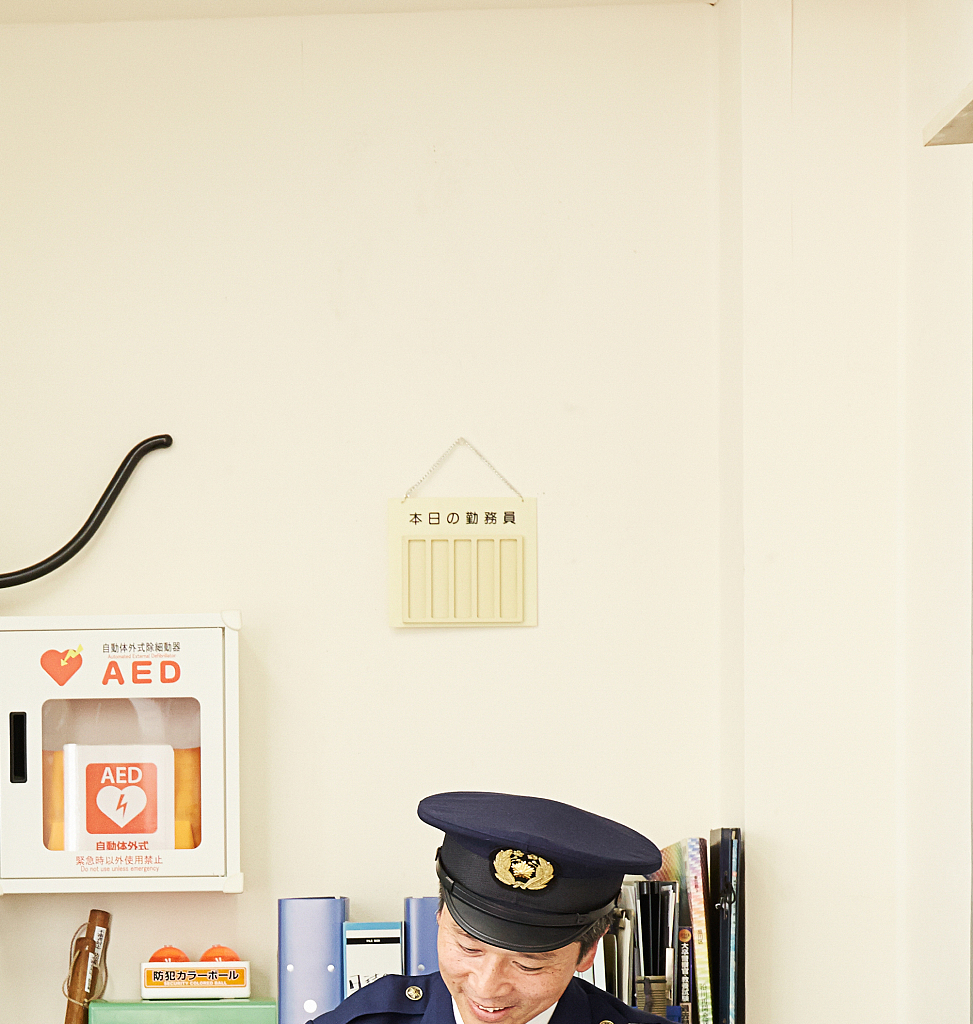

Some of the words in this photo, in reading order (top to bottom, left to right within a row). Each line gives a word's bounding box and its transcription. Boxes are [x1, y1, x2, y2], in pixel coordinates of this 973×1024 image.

[409, 511, 517, 525] 本日の勤務員
[102, 641, 181, 653] 自動体外式除細動器
[102, 660, 181, 685] AED
[100, 766, 143, 784] AED
[96, 841, 149, 851] 自動体外式
[75, 855, 163, 866] 緊急時以外使用禁止
[153, 970, 239, 981] 防犯カラーボール
